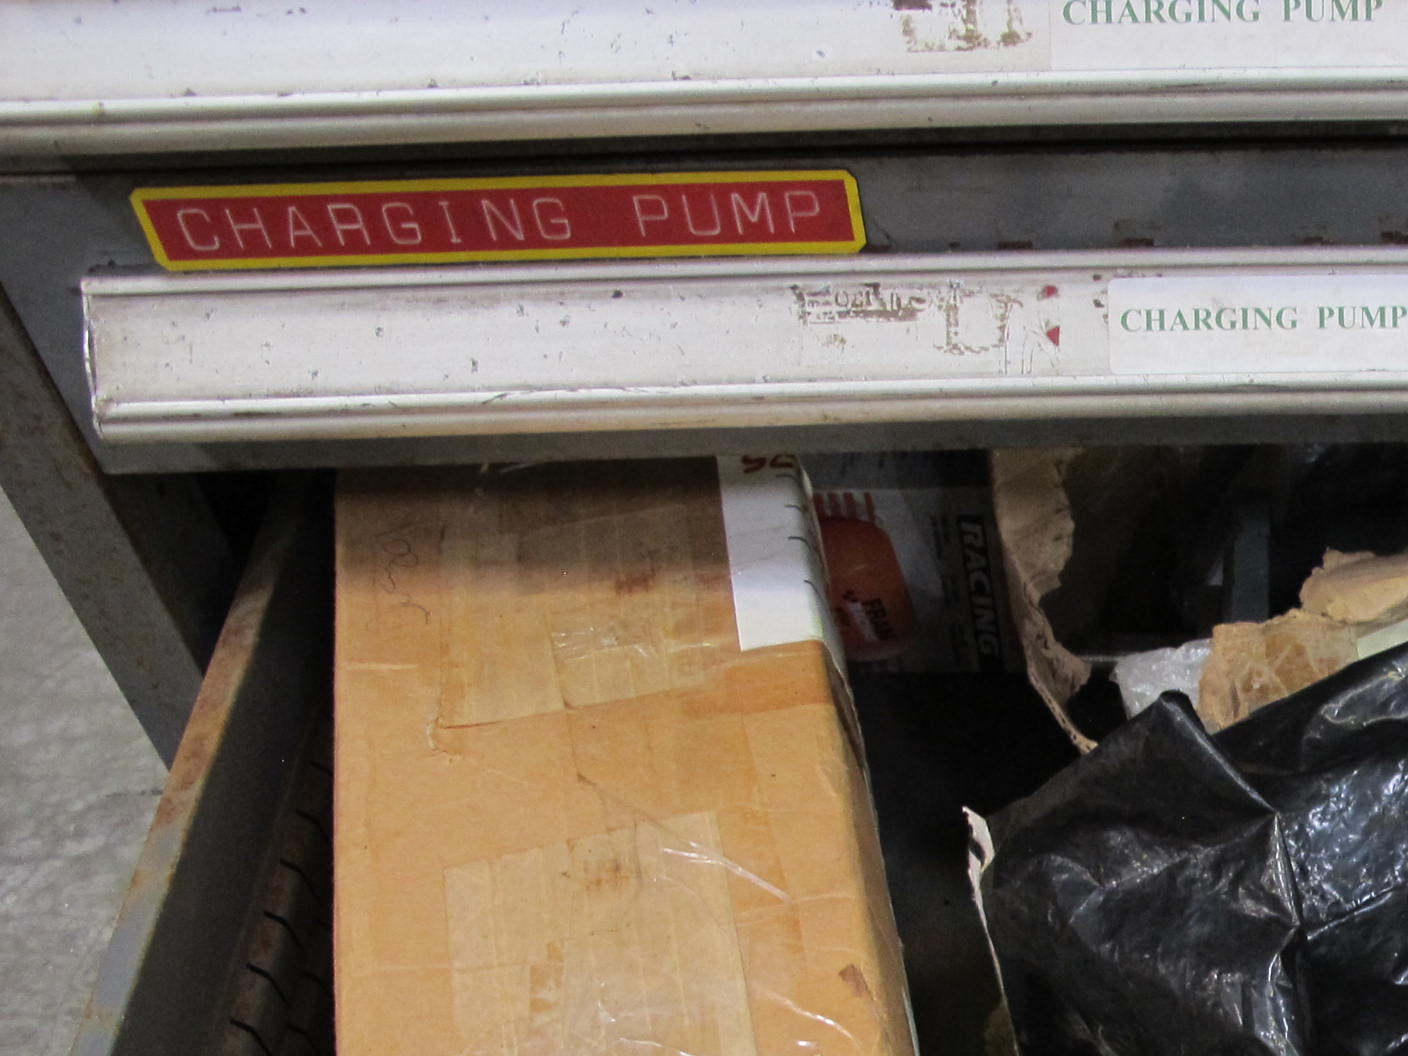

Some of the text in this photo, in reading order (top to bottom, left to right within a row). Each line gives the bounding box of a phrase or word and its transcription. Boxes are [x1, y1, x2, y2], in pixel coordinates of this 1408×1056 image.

[1062, 0, 1384, 26] CHARGING PUMP
[175, 190, 822, 253] CHARGING PUMP
[1120, 304, 1408, 334] CHARGING PUMP
[958, 521, 1001, 658] RACING
